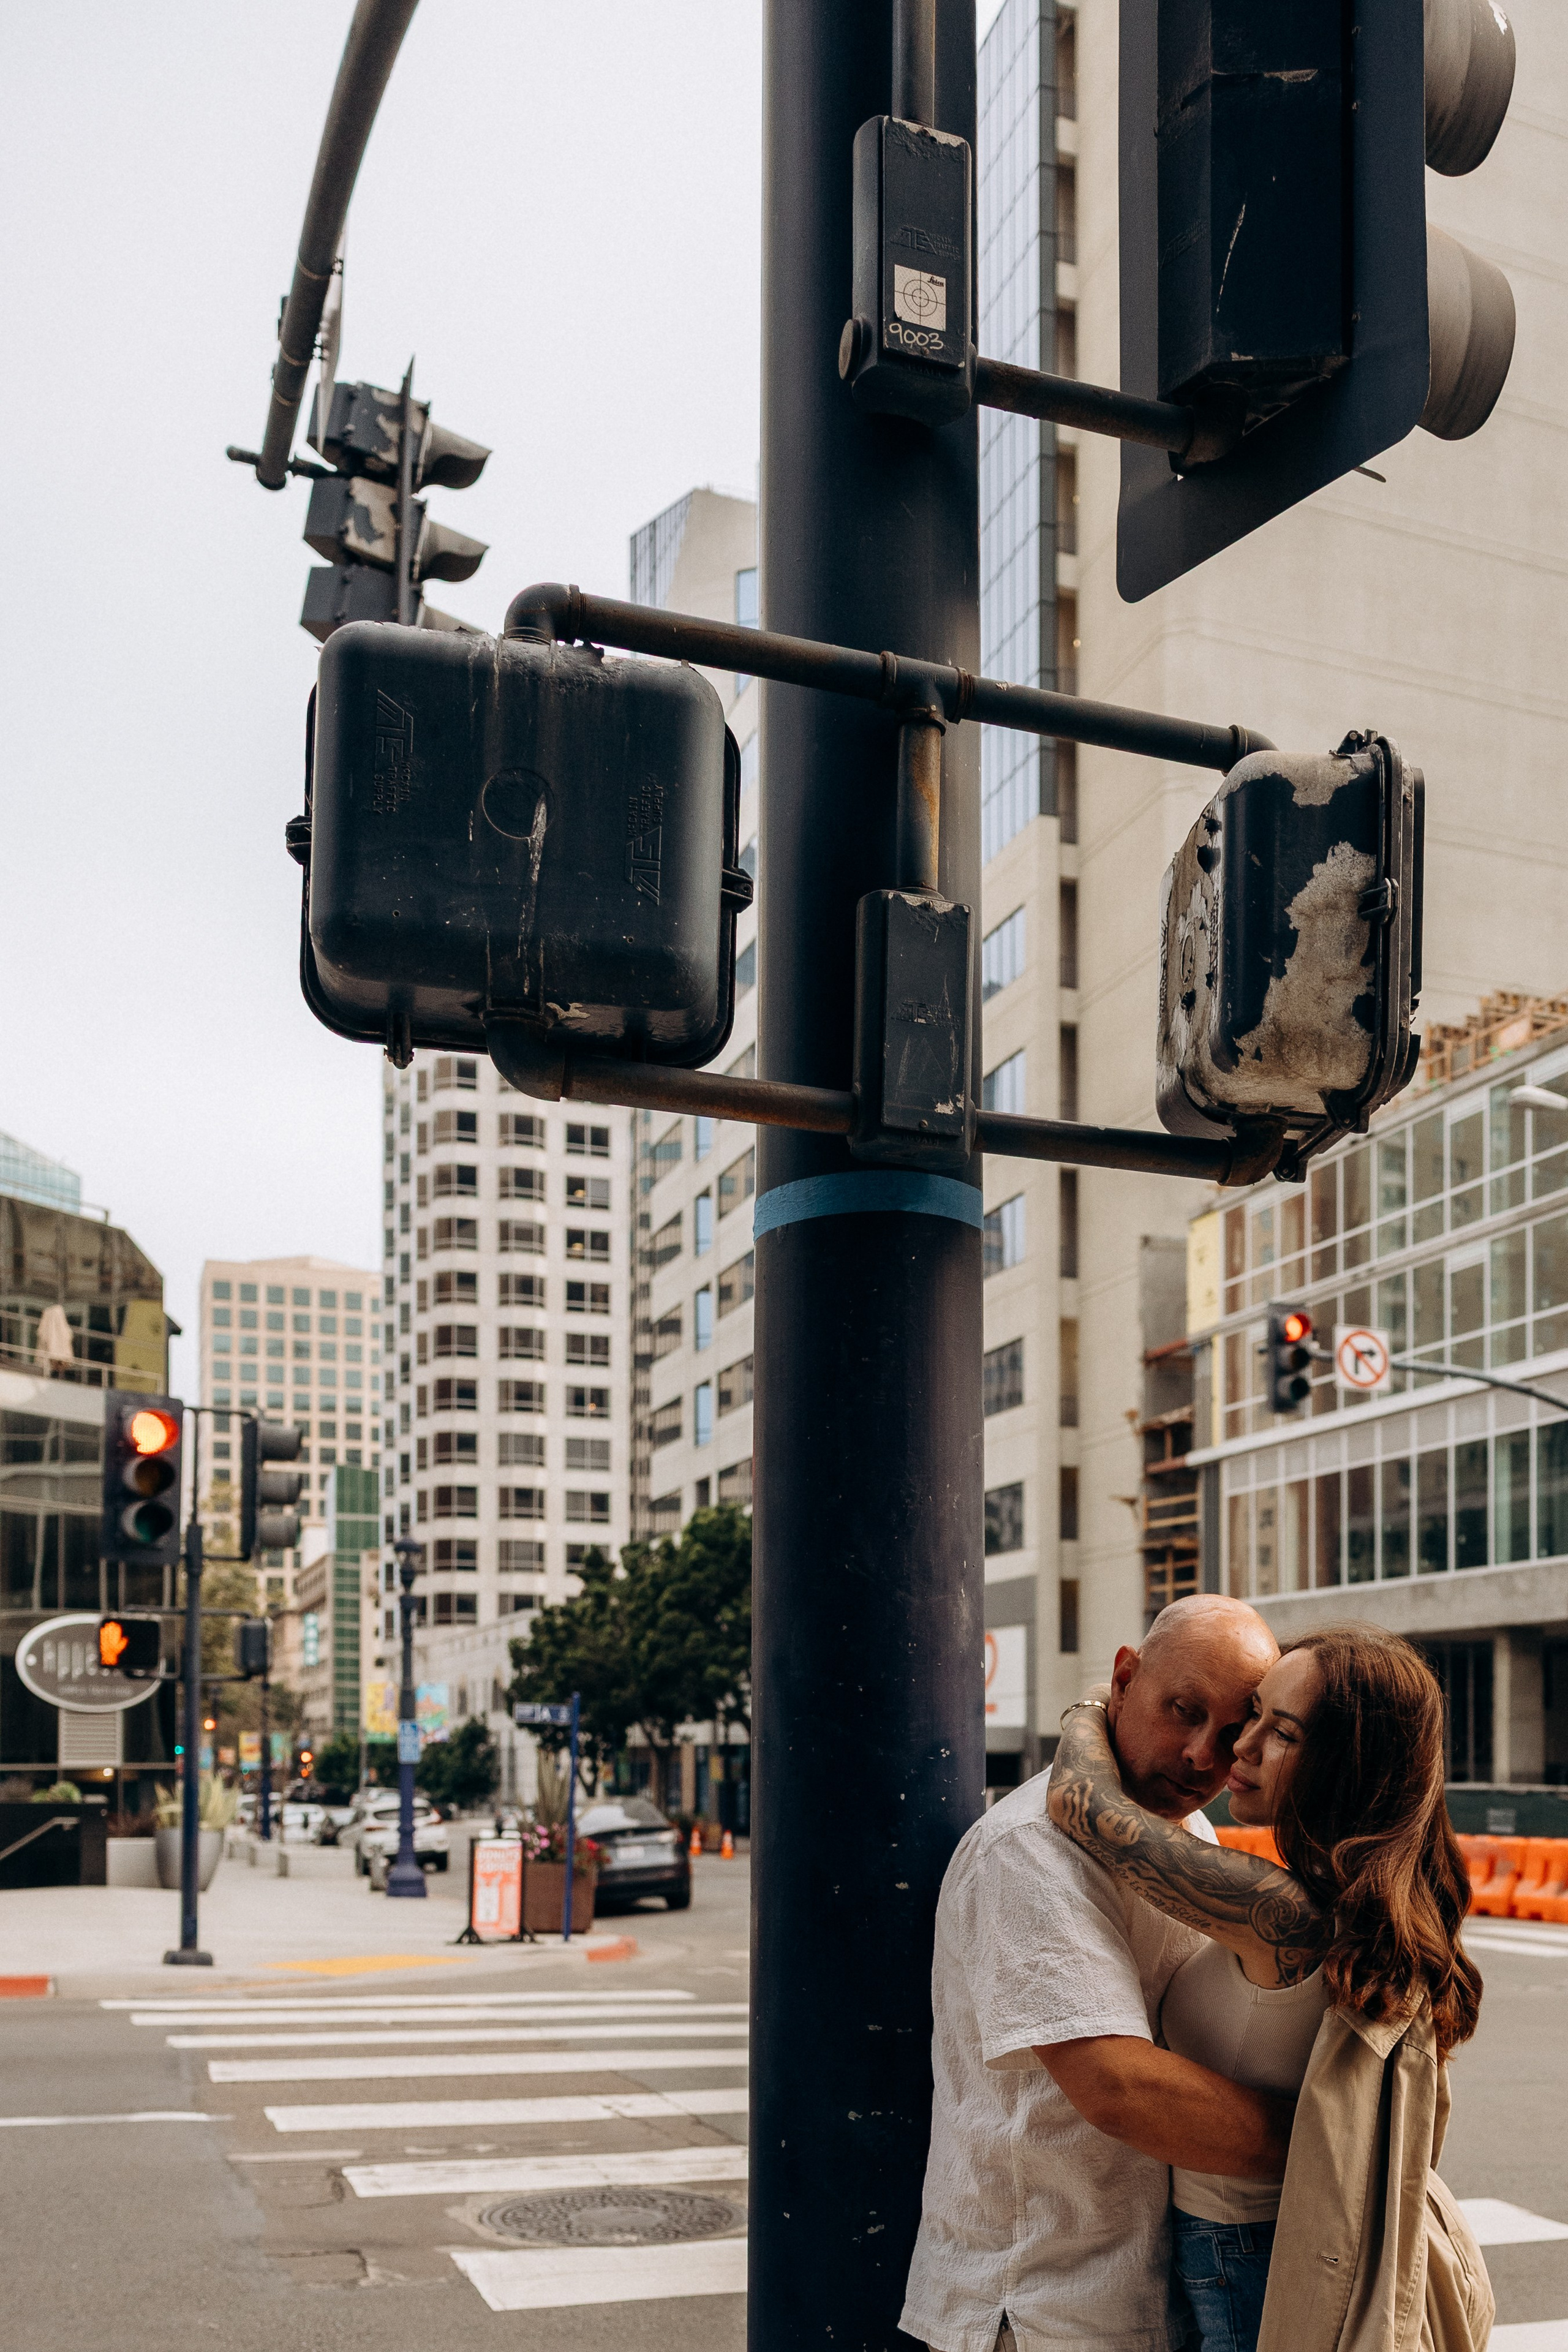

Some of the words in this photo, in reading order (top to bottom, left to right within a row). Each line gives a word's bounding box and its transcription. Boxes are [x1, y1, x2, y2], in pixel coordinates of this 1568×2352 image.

[927, 276, 944, 287] Leica
[889, 323, 944, 349] 9003
[372, 774, 384, 815] SUPPLY
[386, 766, 398, 813] TRAFFIC
[640, 785, 652, 831] TRAFFIC
[653, 783, 664, 823] SUPPLY
